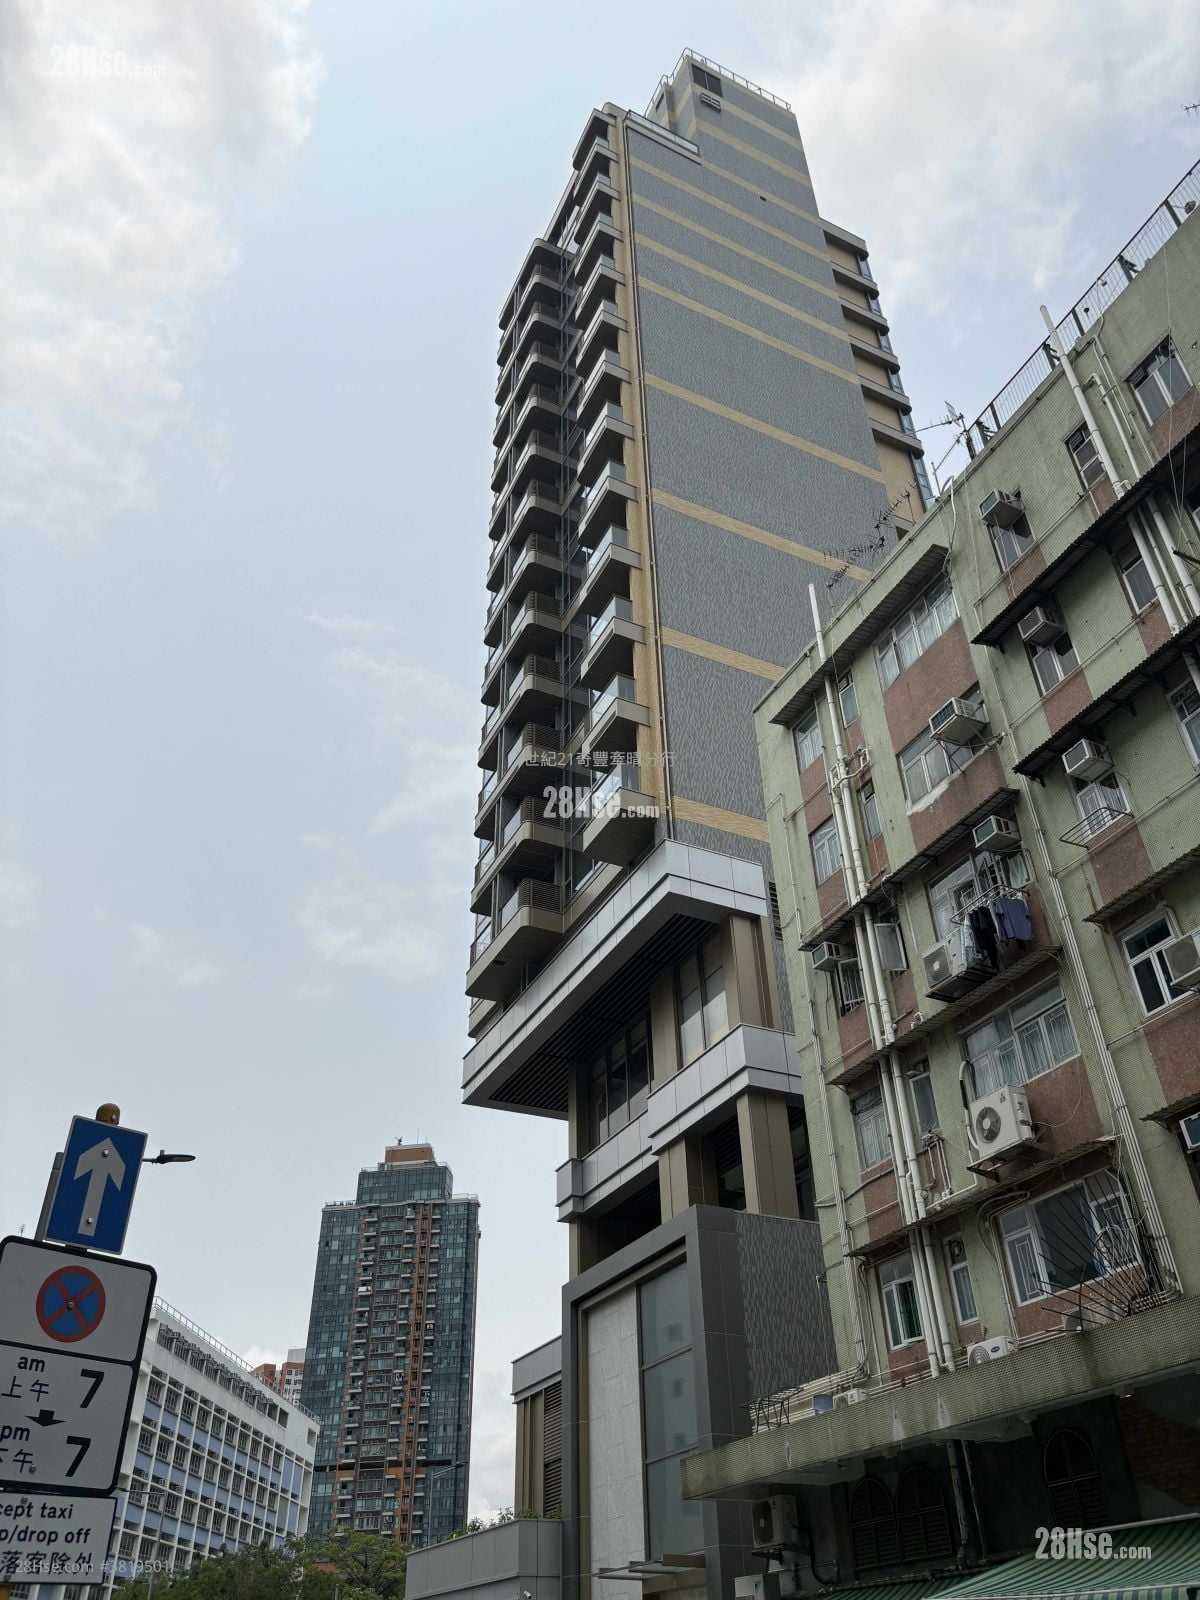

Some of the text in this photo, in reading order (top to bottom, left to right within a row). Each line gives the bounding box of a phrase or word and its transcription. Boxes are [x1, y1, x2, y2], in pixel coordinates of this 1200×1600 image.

[17, 1356, 46, 1372] am
[1, 1375, 49, 1403] 上午
[80, 1368, 105, 1408] 7
[0, 1424, 31, 1442] pm
[65, 1435, 91, 1477] 7
[40, 1503, 74, 1520] taxi
[64, 1527, 92, 1545] off
